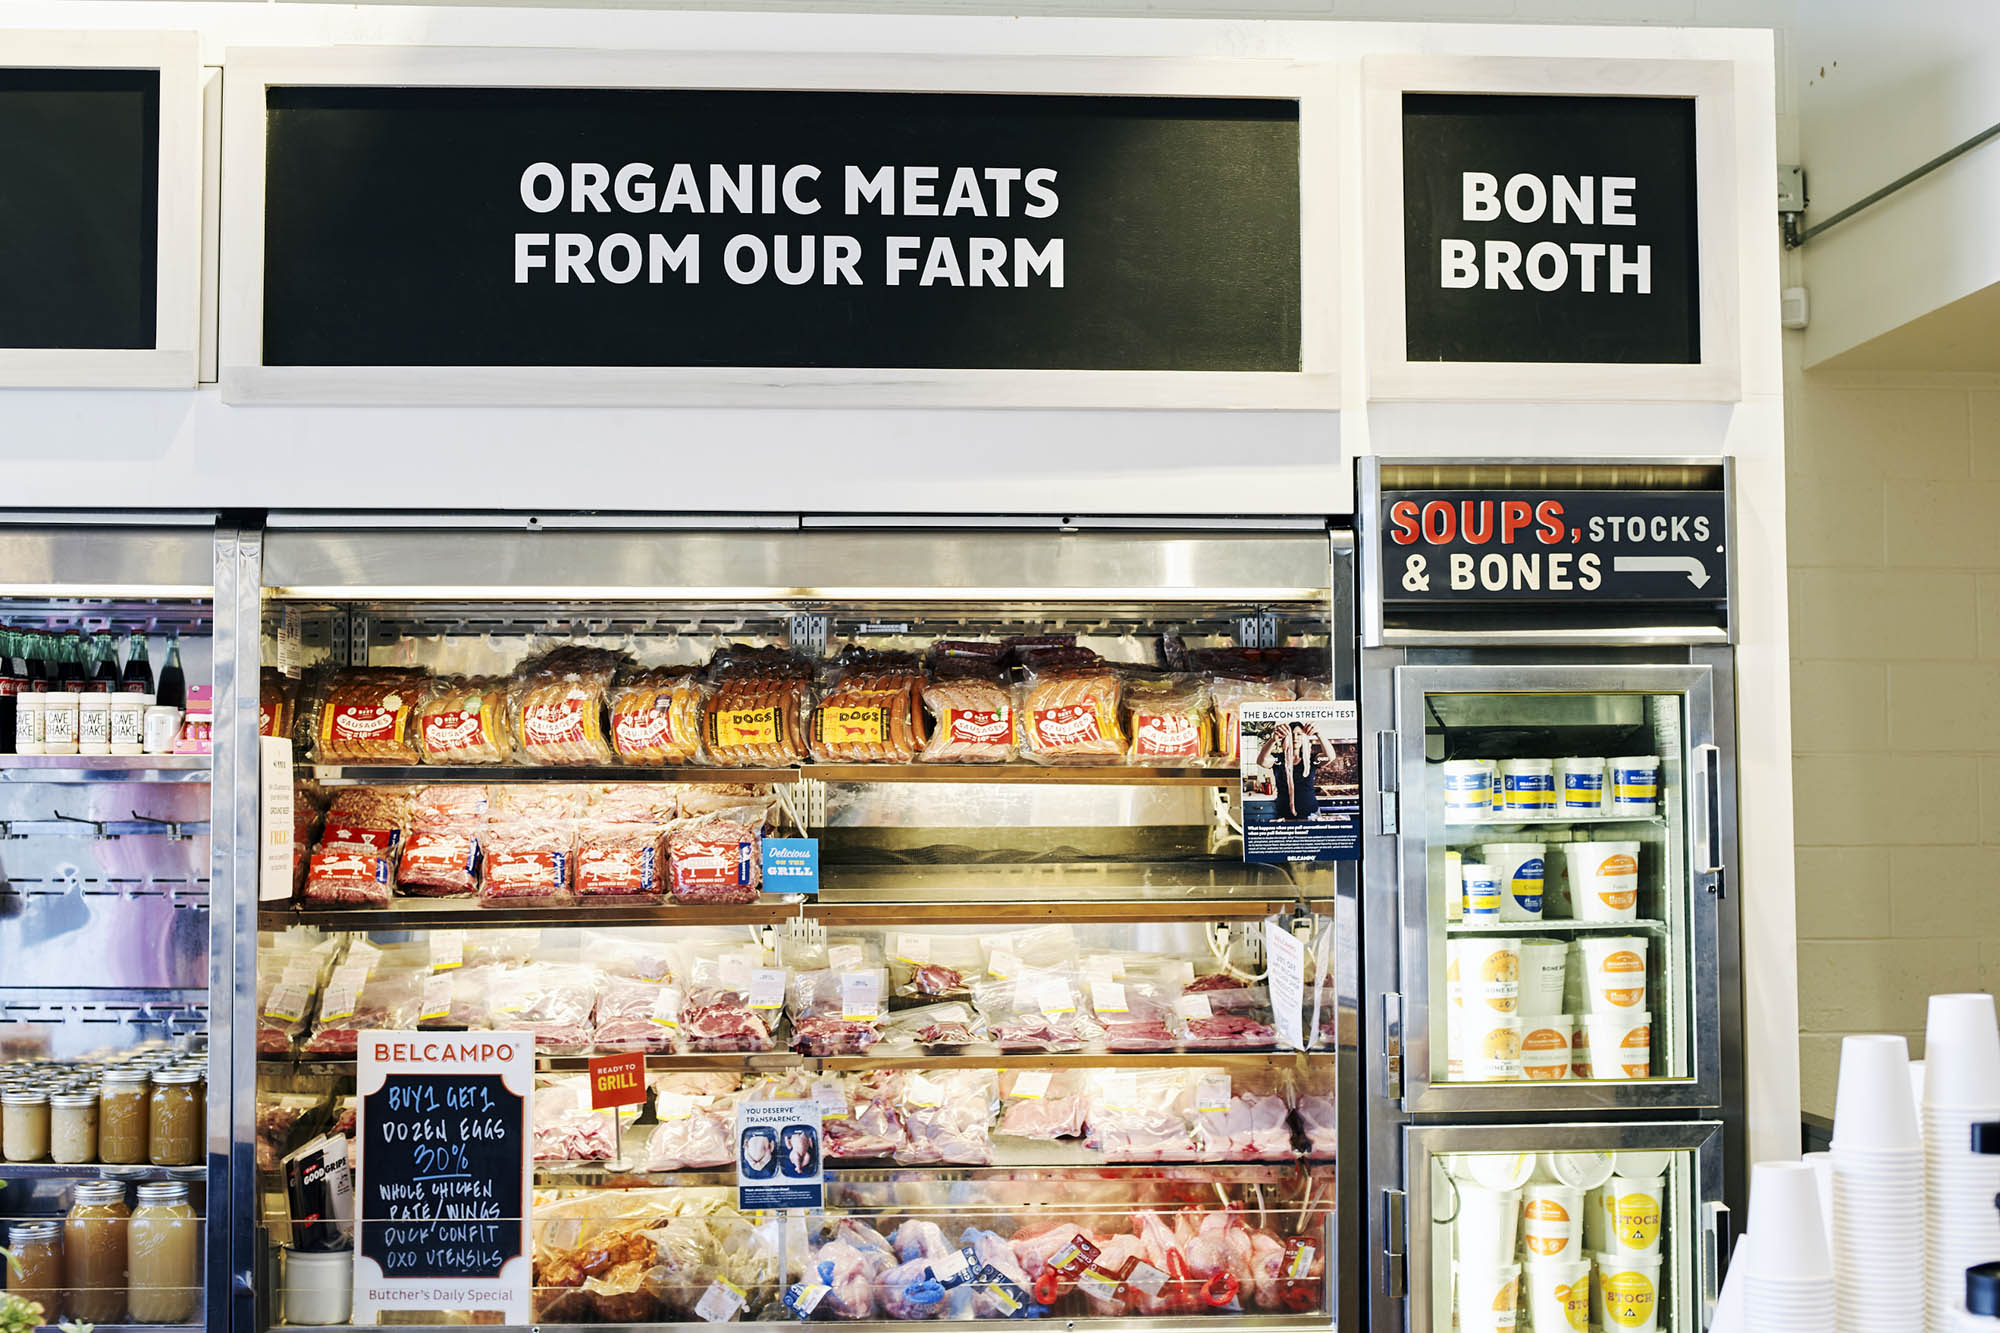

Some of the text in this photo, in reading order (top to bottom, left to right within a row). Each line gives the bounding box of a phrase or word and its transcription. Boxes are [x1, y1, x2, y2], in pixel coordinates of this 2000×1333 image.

[520, 162, 1060, 218] ORGANIC MEATS
[1462, 172, 1636, 226] BONE
[514, 232, 1065, 288] FROM OUR FARM
[1441, 239, 1651, 294] BROTH
[1390, 500, 1710, 545] SOUPS, STOCKS
[1401, 553, 1602, 592] & BONES
[17, 713, 30, 725] AVE
[49, 712, 69, 724] CAVE
[82, 713, 102, 725] CAVE
[112, 714, 134, 726] CAVE
[733, 711, 772, 725] DOGS
[839, 711, 879, 722] DOGS
[1243, 711, 1260, 719] THE
[1295, 710, 1334, 718] STRETCH
[1335, 710, 1355, 718] TEST
[47, 724, 72, 736] SHAKE
[340, 717, 389, 729] SAUSAGES
[431, 722, 476, 738] SAUSAGES
[957, 722, 1005, 734] SAUSAGES
[1043, 716, 1090, 733] SAUSAGES
[17, 725, 33, 736] AKE
[80, 725, 106, 736] SHAKE
[112, 725, 138, 737] SHAKE
[768, 847, 811, 858] Delicious
[767, 867, 814, 876] GRILL
[375, 1043, 516, 1063] BELCAMPO
[597, 1063, 636, 1075] READY TO
[598, 1072, 638, 1092] GRILL
[382, 1117, 506, 1143] DOZEN EGGS
[413, 1143, 470, 1174] 30%
[303, 1167, 325, 1185] GOOD
[379, 1179, 493, 1201] WHOLE CHICKEN
[384, 1223, 500, 1247] DUCK CONFIT
[387, 1248, 503, 1270] OXO UTENSILS
[368, 1289, 513, 1303] Butcher's Daily Special
[1607, 1291, 1652, 1304] STOCK
[1567, 1300, 1589, 1310] STO
